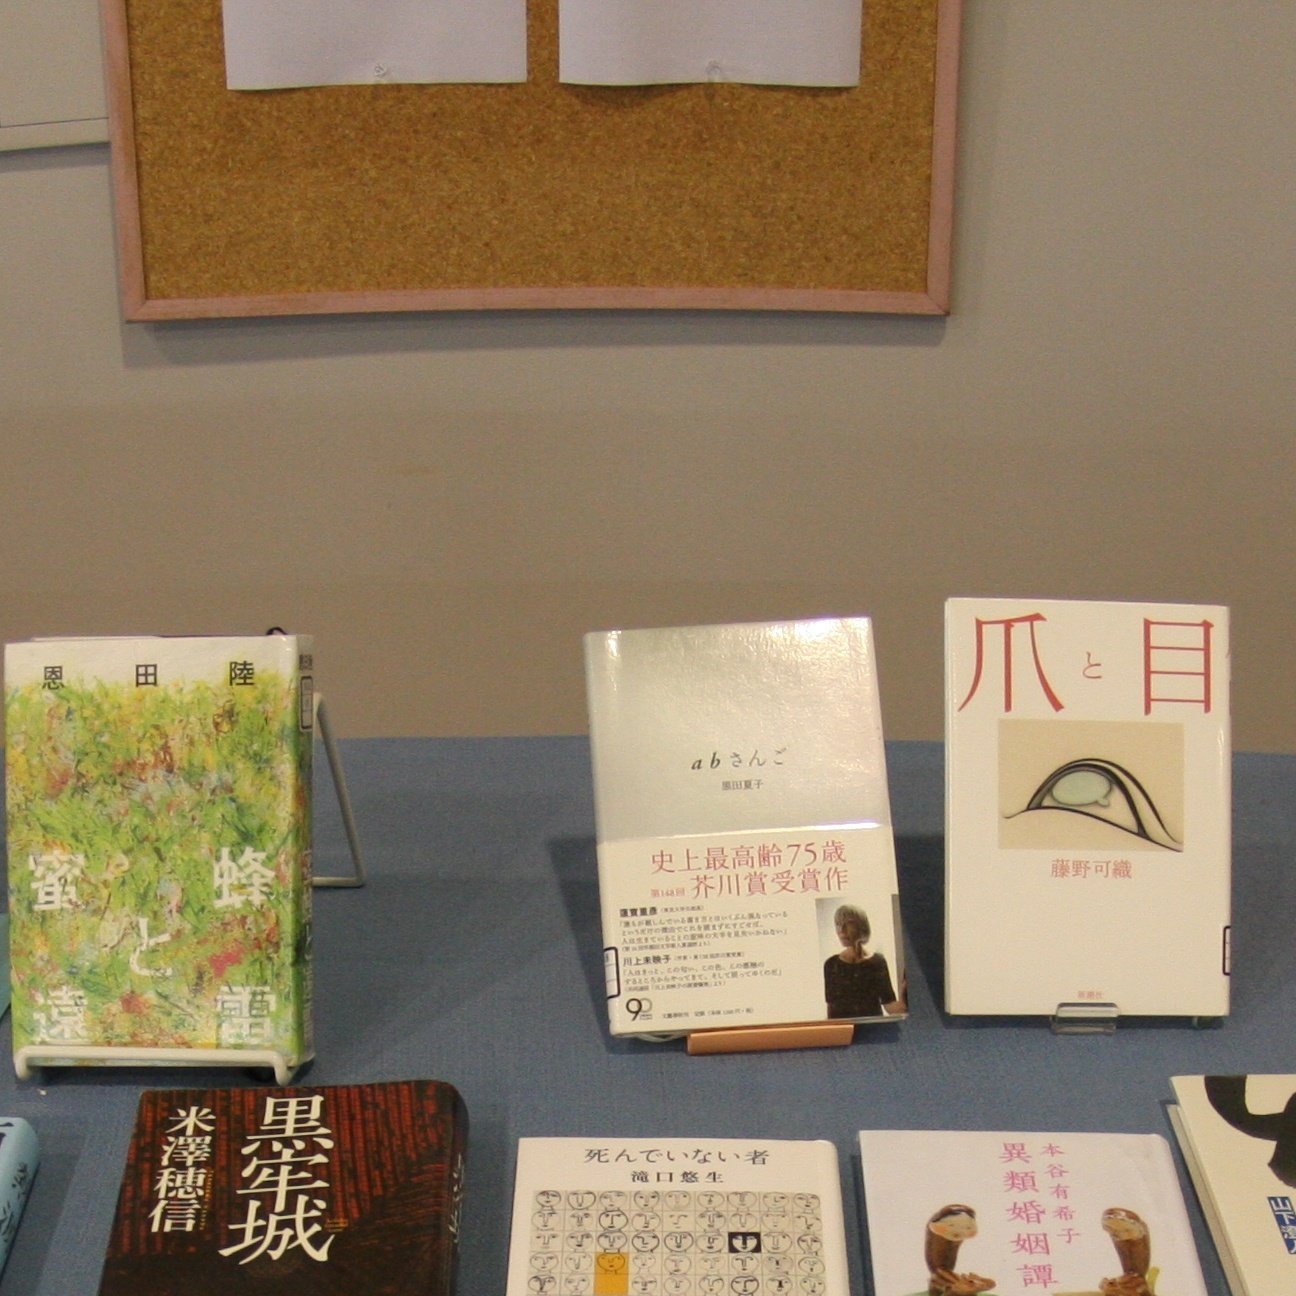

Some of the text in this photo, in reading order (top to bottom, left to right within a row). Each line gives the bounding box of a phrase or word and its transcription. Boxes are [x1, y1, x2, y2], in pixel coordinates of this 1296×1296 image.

[42, 660, 256, 691] 恩田陸
[957, 612, 1215, 716] 爪と目
[721, 779, 764, 792] 黒田夏子
[29, 847, 276, 911] 蜜蜂
[651, 839, 847, 874] 史上最高齢75歳
[1051, 858, 1133, 879] 藤野可織
[692, 867, 848, 898] 芥川賞受賞作
[129, 918, 172, 976] と
[622, 955, 671, 967] 川上未映子
[33, 985, 276, 1046] 遠雷
[149, 1105, 217, 1233] 米澤穂信
[218, 1094, 335, 1265] 黒牢城
[584, 1147, 769, 1166] 死んでいない者
[630, 1169, 724, 1184] 滝口悠生
[1000, 1142, 1058, 1288] 異類婚姻譚
[1040, 1142, 1080, 1245] 本谷有希子
